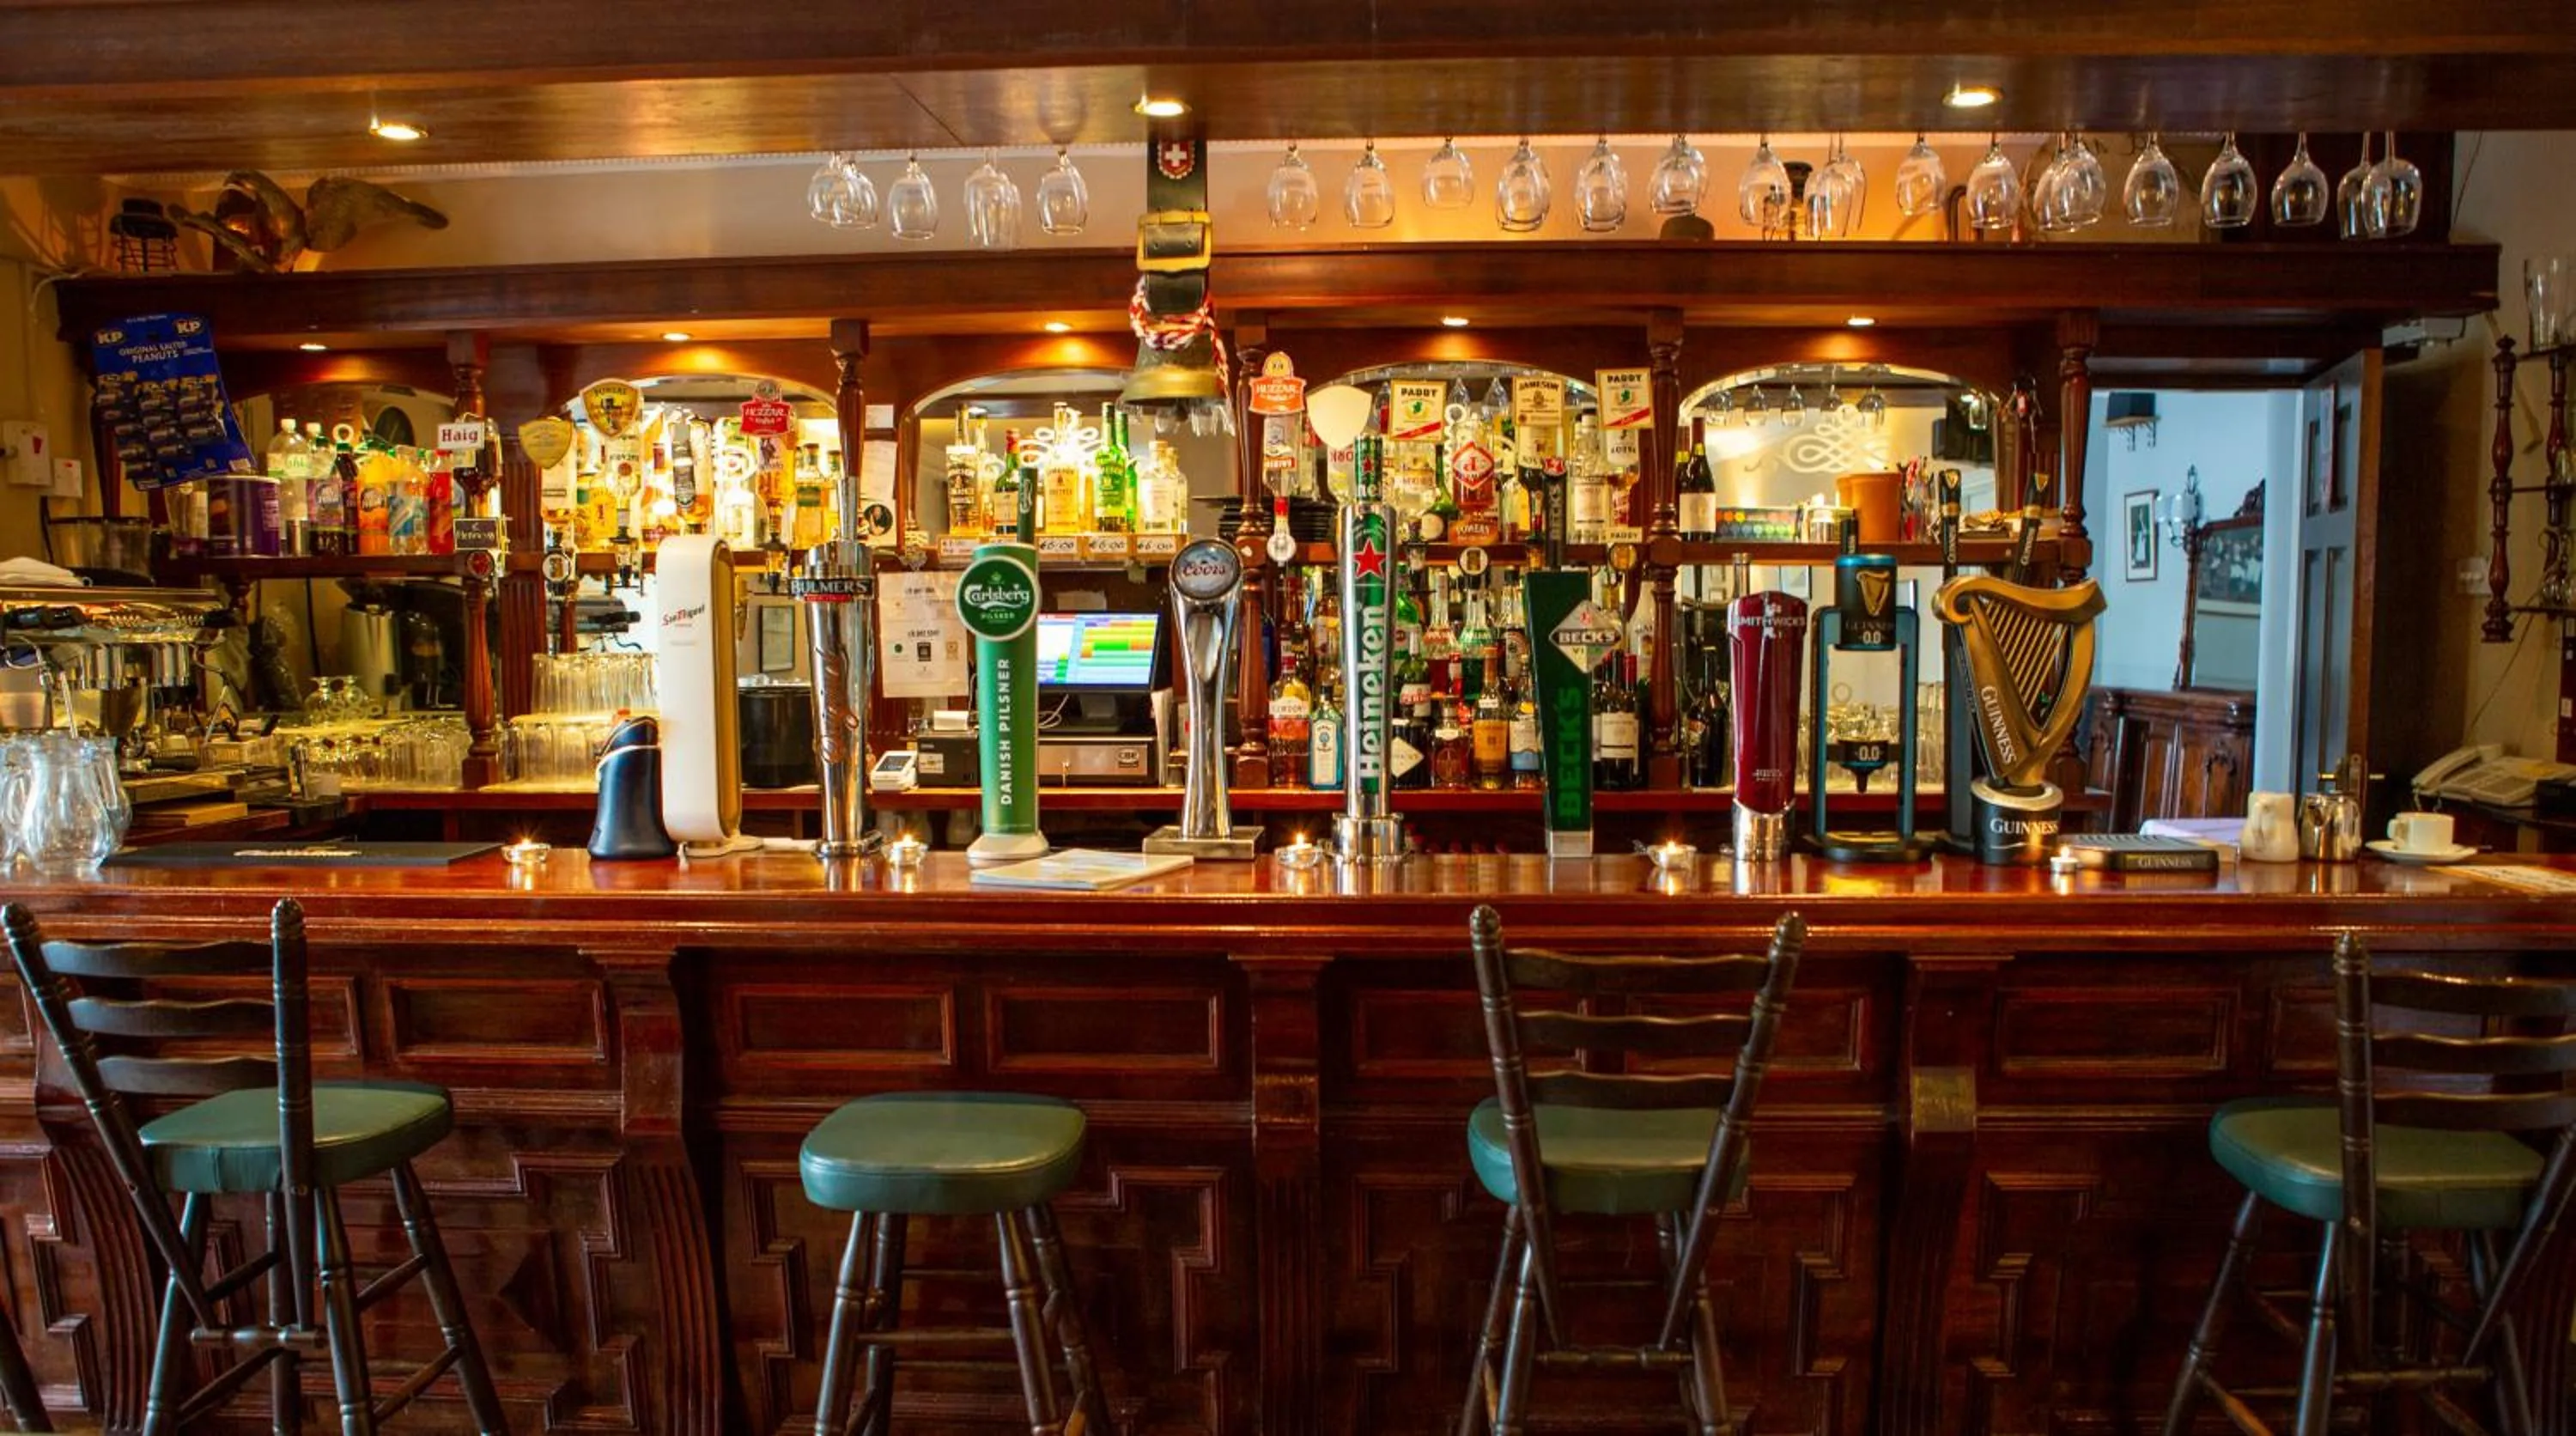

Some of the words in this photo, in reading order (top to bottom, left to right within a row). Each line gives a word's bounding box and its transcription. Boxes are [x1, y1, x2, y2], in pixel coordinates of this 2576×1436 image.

[177, 319, 201, 334] KP
[96, 330, 124, 344] KP
[132, 350, 179, 363] PEANUTS
[1519, 380, 1560, 392] JAMESON
[1607, 374, 1642, 383] PADDY
[1400, 387, 1437, 397] PADDY
[441, 429, 478, 443] Haig
[1182, 562, 1226, 576] Coors
[791, 579, 867, 594] BULMERS
[964, 583, 1030, 606] Carlsberg
[998, 659, 1011, 733] PILSNER
[1358, 605, 1384, 778] Heineken
[1980, 685, 2017, 766] GUINNESS
[1858, 745, 1880, 761] 0.0
[1000, 739, 1012, 806] DANISH
[1989, 817, 2059, 835] GUINNESS
[2137, 854, 2192, 868] GUINNESS
